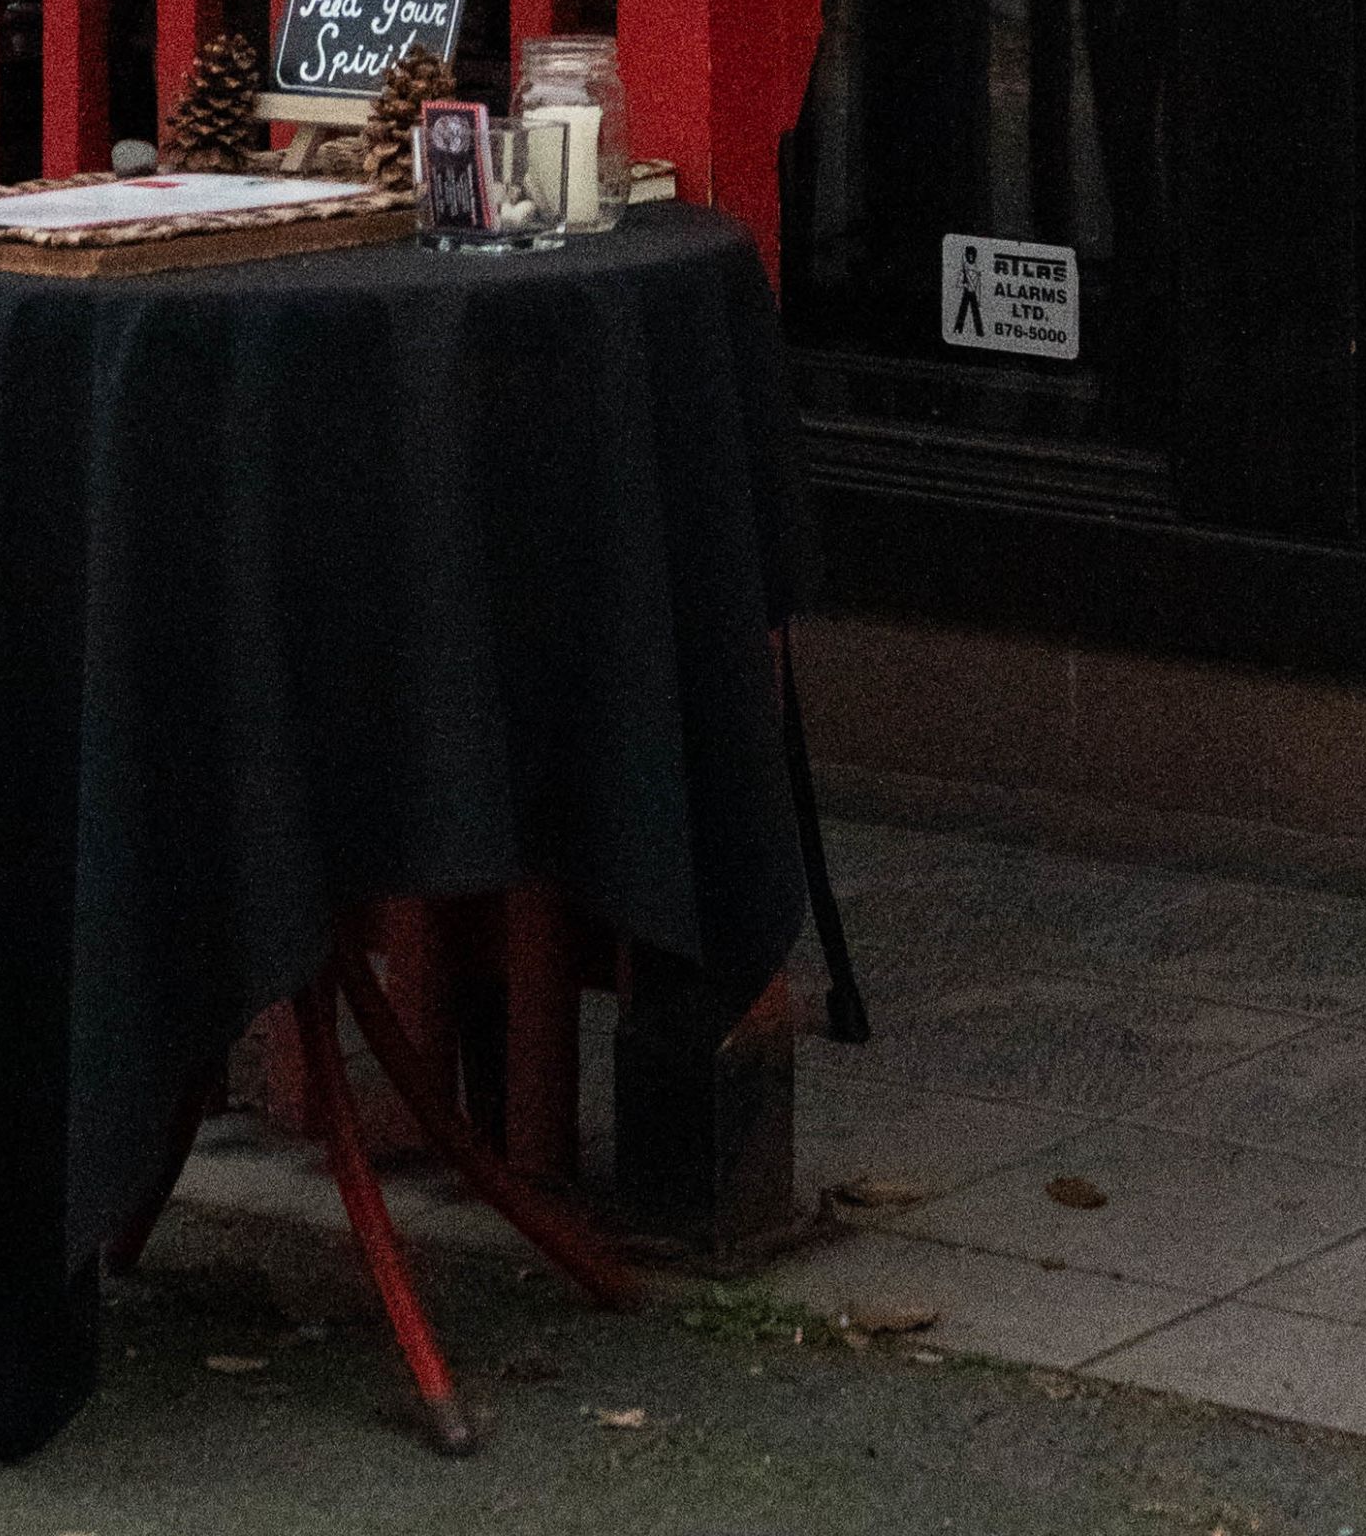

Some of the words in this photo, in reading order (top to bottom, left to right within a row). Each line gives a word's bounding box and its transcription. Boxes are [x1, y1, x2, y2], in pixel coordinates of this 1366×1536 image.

[994, 254, 1066, 282] ATLAS
[995, 282, 1067, 304] ALARMS
[1012, 303, 1049, 322] LTD.
[994, 322, 1067, 344] 876-5000
